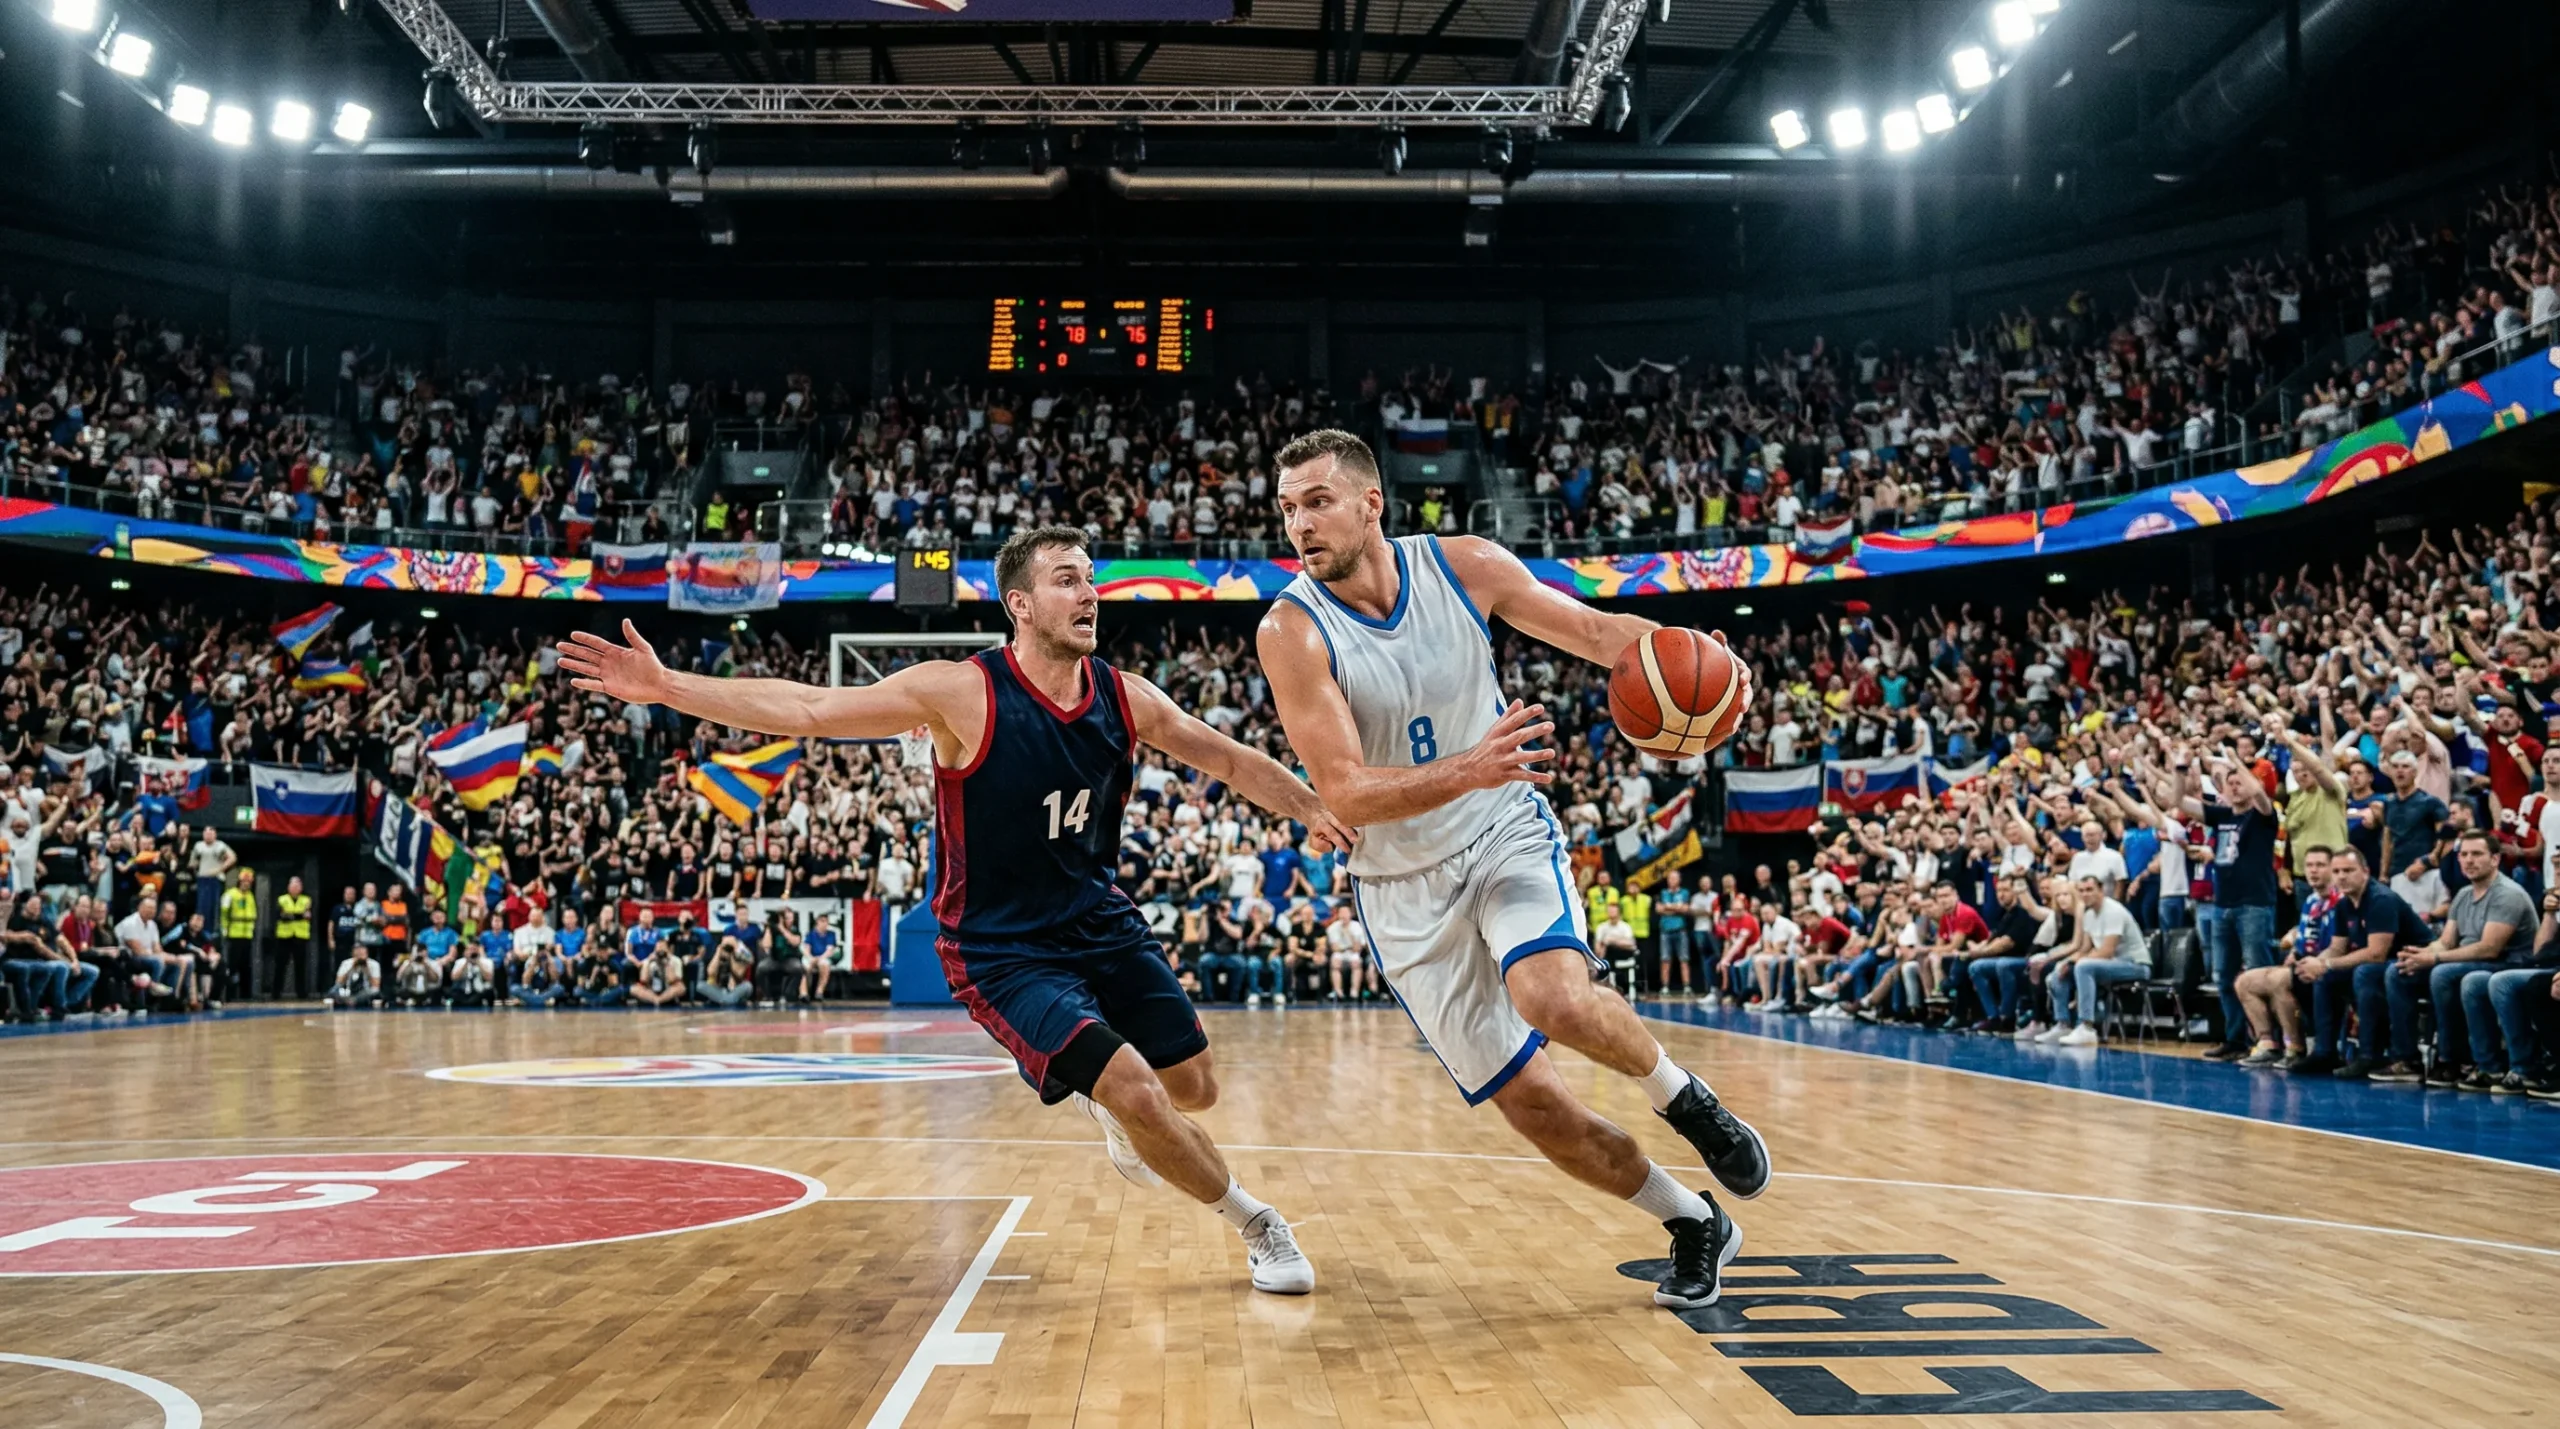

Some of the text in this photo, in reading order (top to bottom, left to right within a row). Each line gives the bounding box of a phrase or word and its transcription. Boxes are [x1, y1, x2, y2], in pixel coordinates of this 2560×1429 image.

[1407, 715, 1437, 765] 8
[1042, 788, 1091, 840] 14
[1615, 1252, 2285, 1417] FIBA
